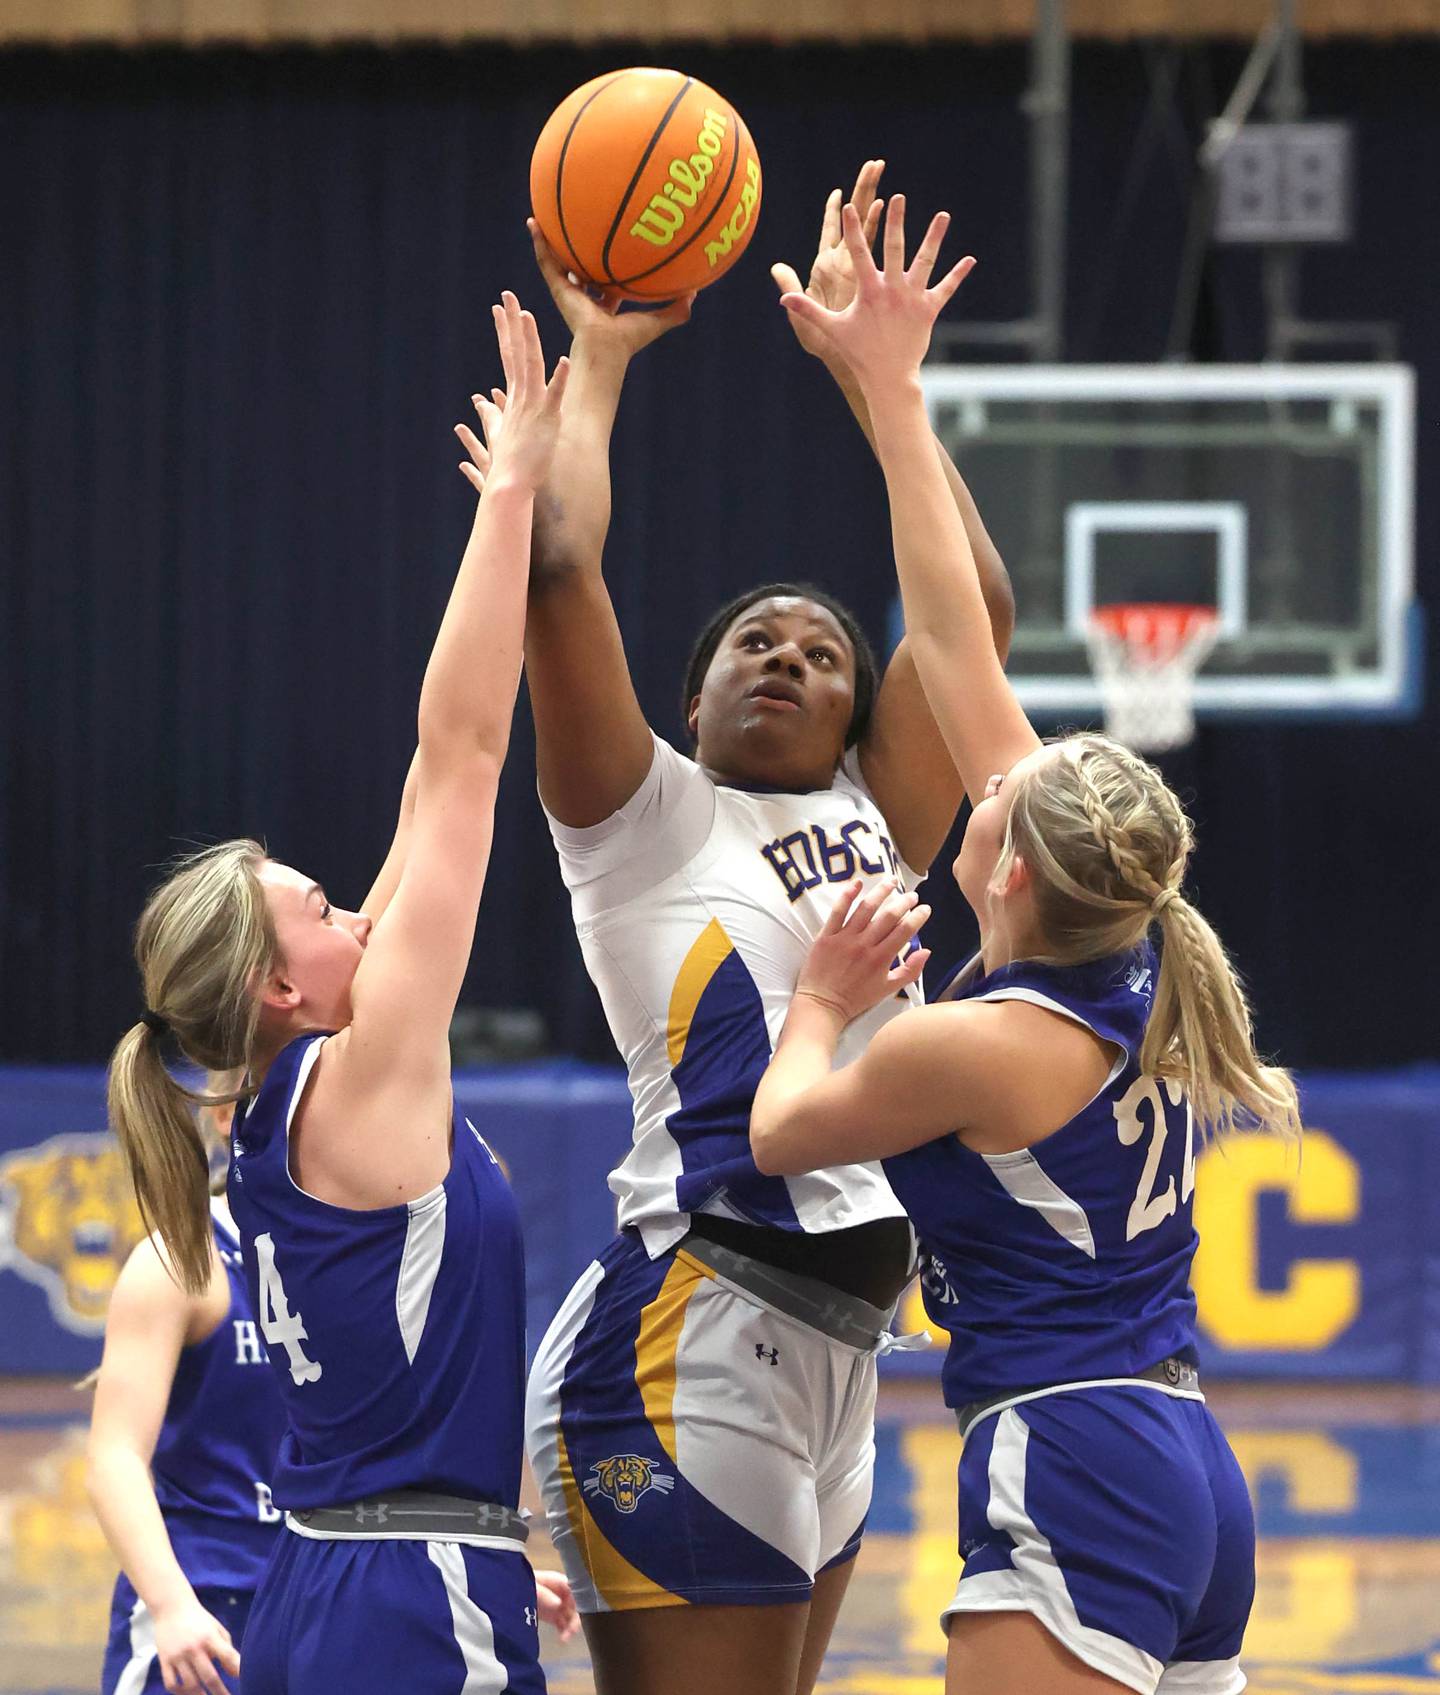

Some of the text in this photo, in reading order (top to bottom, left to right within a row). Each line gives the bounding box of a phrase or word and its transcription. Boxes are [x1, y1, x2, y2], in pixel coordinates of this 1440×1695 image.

[630, 107, 728, 246] Wilson
[704, 158, 760, 267] NCAA
[761, 819, 906, 903] BOBC
[232, 1319, 271, 1364] H
[254, 1232, 323, 1386] 4
